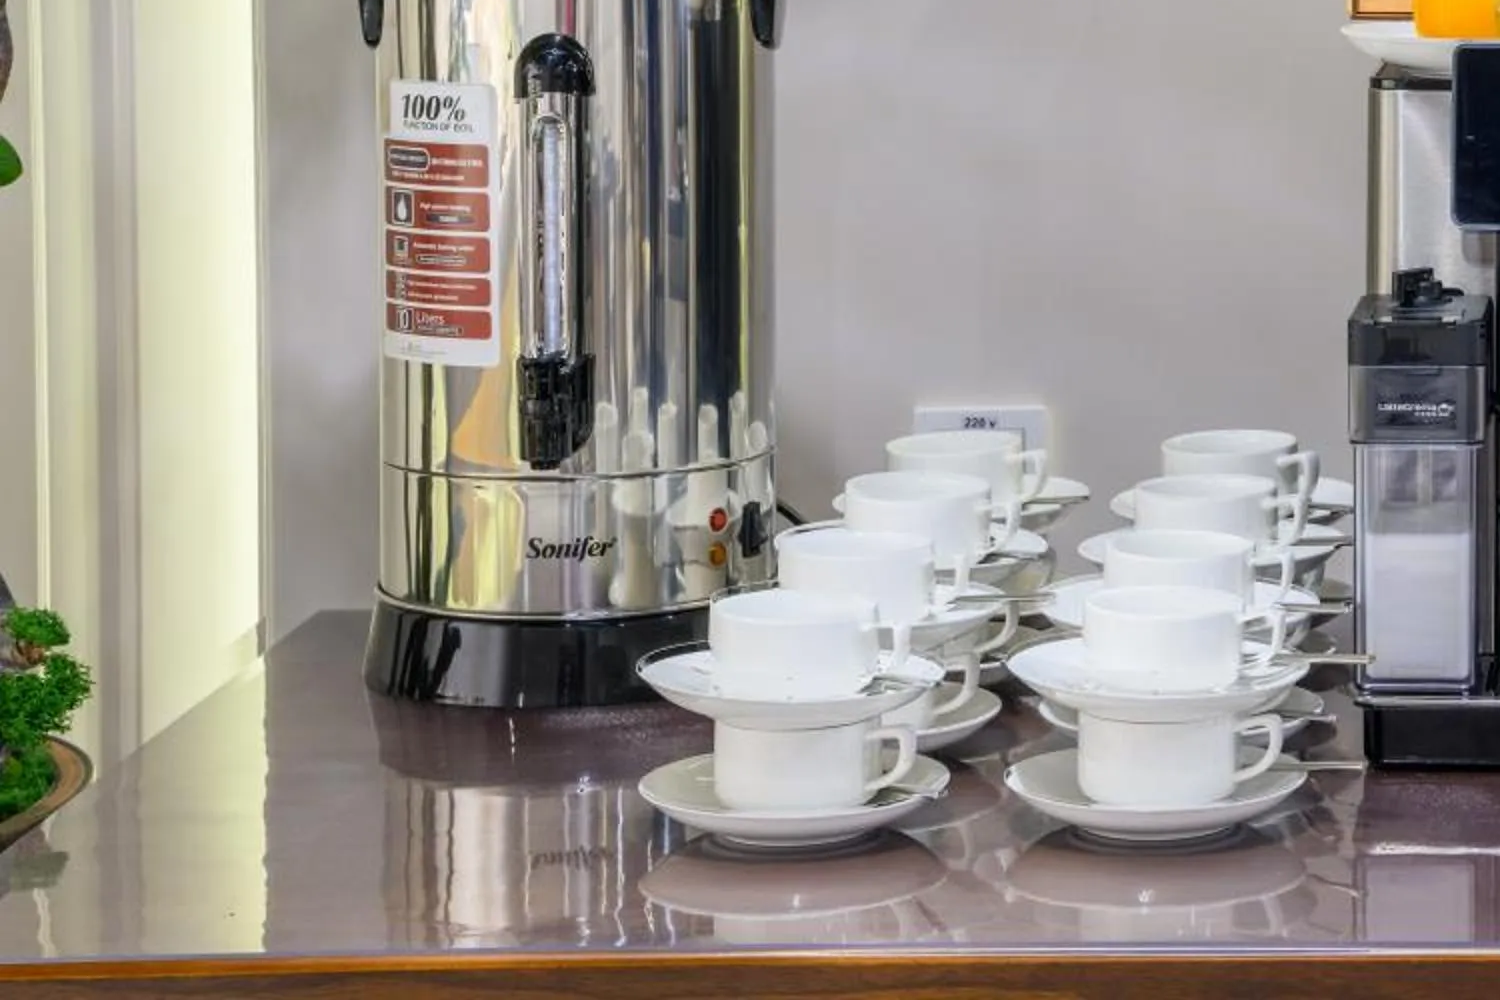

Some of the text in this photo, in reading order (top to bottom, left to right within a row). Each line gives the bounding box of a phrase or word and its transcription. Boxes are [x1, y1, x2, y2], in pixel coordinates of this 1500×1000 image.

[402, 93, 466, 122] 100%
[964, 416, 986, 429] 220
[525, 536, 614, 563] Sonifer
